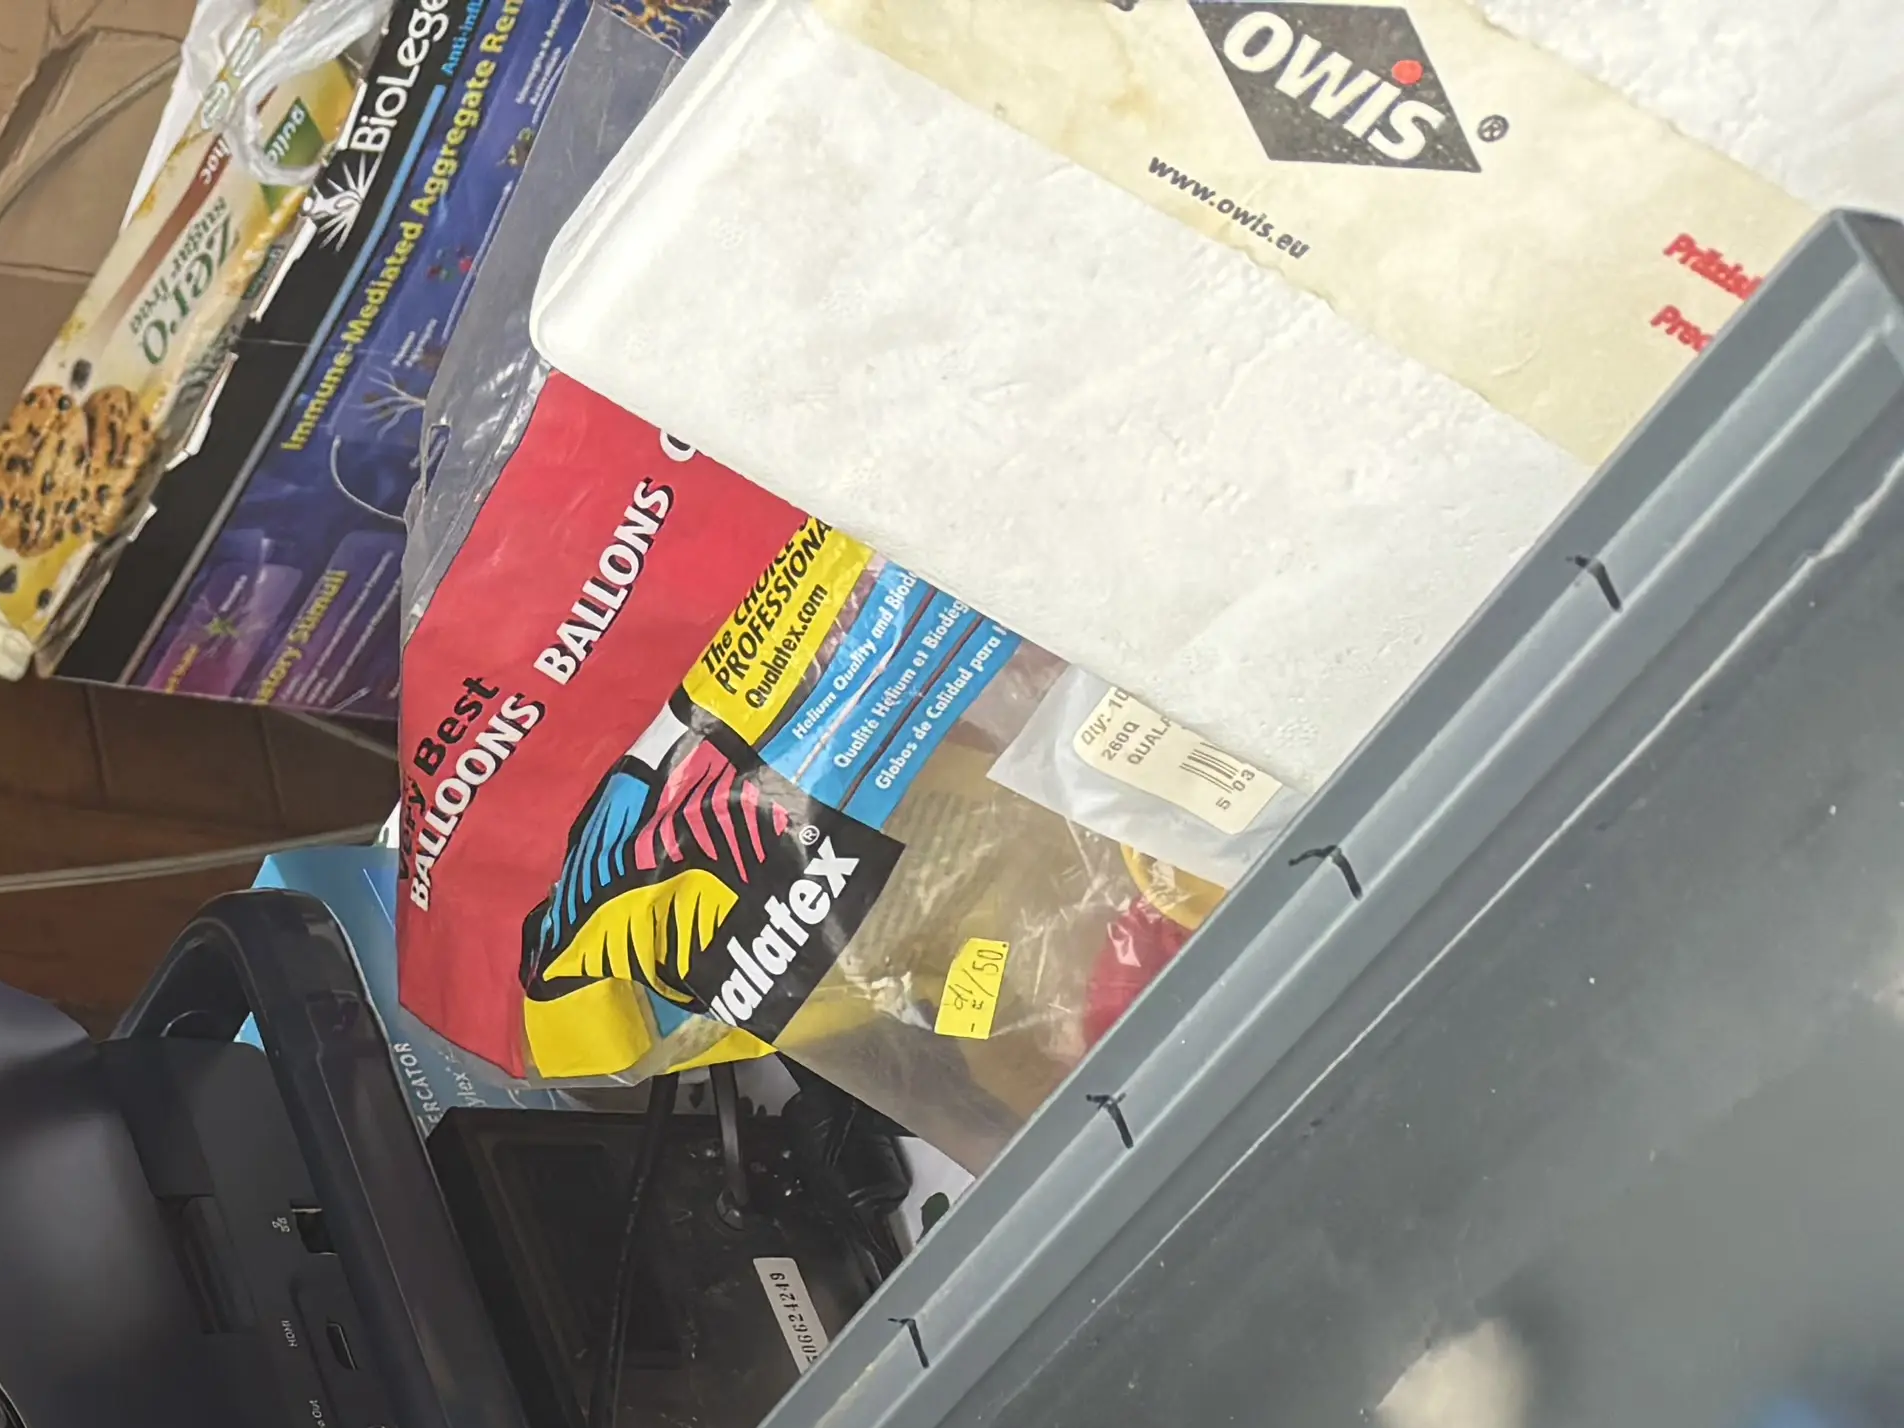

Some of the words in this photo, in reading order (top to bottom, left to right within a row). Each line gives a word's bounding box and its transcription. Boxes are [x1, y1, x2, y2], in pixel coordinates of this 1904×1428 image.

[1222, 10, 1446, 161] OWIS
[195, 134, 233, 184] hoc
[1148, 156, 1311, 260] www.owis.eu
[281, 221, 424, 450] Immune-Mediated
[410, 59, 498, 216] Aggregate
[700, 630, 733, 675] The
[714, 515, 833, 696] PROFESSIONA
[744, 583, 829, 710] Qualatex.com
[409, 693, 546, 913] BALLOONS
[531, 476, 675, 686] BALLONS
[790, 692, 839, 741] Helium
[832, 639, 878, 692] Quality
[870, 606, 896, 639] and
[832, 719, 881, 769] Qualité
[871, 668, 919, 718] Hélium
[910, 651, 929, 668] et
[922, 598, 971, 649] Biodég
[873, 741, 919, 790] Globos
[910, 720, 933, 741] de
[925, 666, 974, 720] Calidad
[970, 634, 1003, 670] para
[1080, 713, 1112, 746] Qty:
[1107, 686, 1130, 710] 10
[412, 676, 501, 777] Best
[1100, 720, 1141, 761] 260Q
[1126, 715, 1172, 765] QUALA
[1231, 768, 1256, 792] 03
[708, 835, 861, 1028] ualatex
[393, 1041, 443, 1124] ERCATOR
[281, 1320, 298, 1347] HDMI
[769, 1272, 818, 1366] 506624249
[308, 1399, 324, 1418] Out
